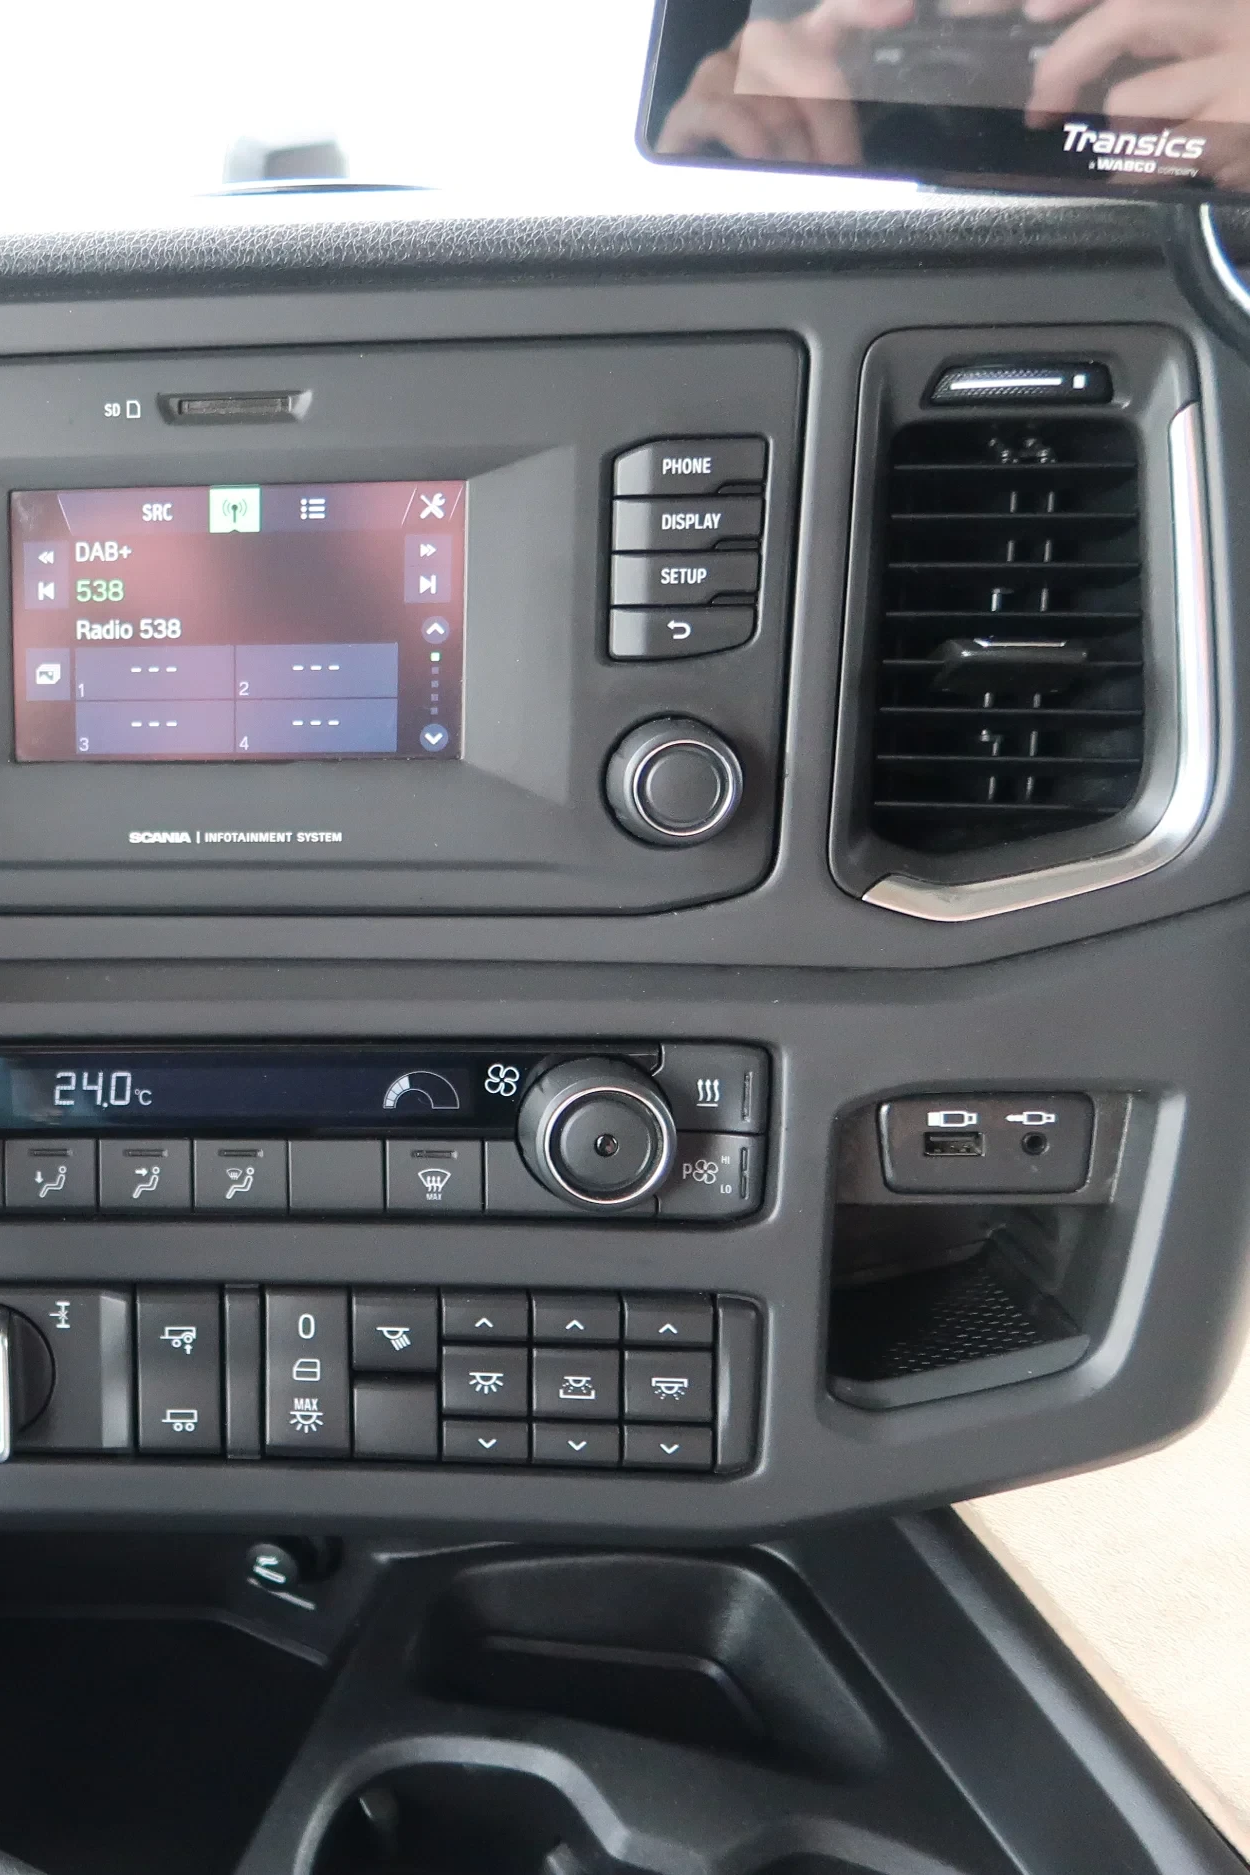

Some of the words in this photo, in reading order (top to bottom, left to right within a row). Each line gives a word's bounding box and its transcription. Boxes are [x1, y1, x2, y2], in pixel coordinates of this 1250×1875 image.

[1063, 122, 1206, 159] Transics
[1097, 156, 1157, 173] WABCO
[104, 403, 121, 417] SD
[662, 457, 711, 474] PHONE
[141, 503, 173, 522] SRC
[661, 513, 721, 530] DISPLAY
[75, 541, 132, 562] DAB+
[660, 568, 707, 585] SETUP
[76, 580, 124, 602] 538
[76, 619, 132, 641] Radio
[139, 618, 182, 639] 538
[78, 683, 85, 698] 1
[238, 681, 249, 697] 2
[79, 737, 90, 752] 3
[238, 736, 250, 751] 4
[129, 831, 192, 843] SCANIA
[205, 831, 293, 843] INFOTAINMENT
[297, 831, 342, 843] SYSTEM
[721, 1156, 731, 1164] HI
[683, 1163, 692, 1179] P
[426, 1192, 442, 1201] MAX
[720, 1184, 732, 1194] LO
[298, 1313, 315, 1339] 0
[294, 1398, 318, 1411] MAX
